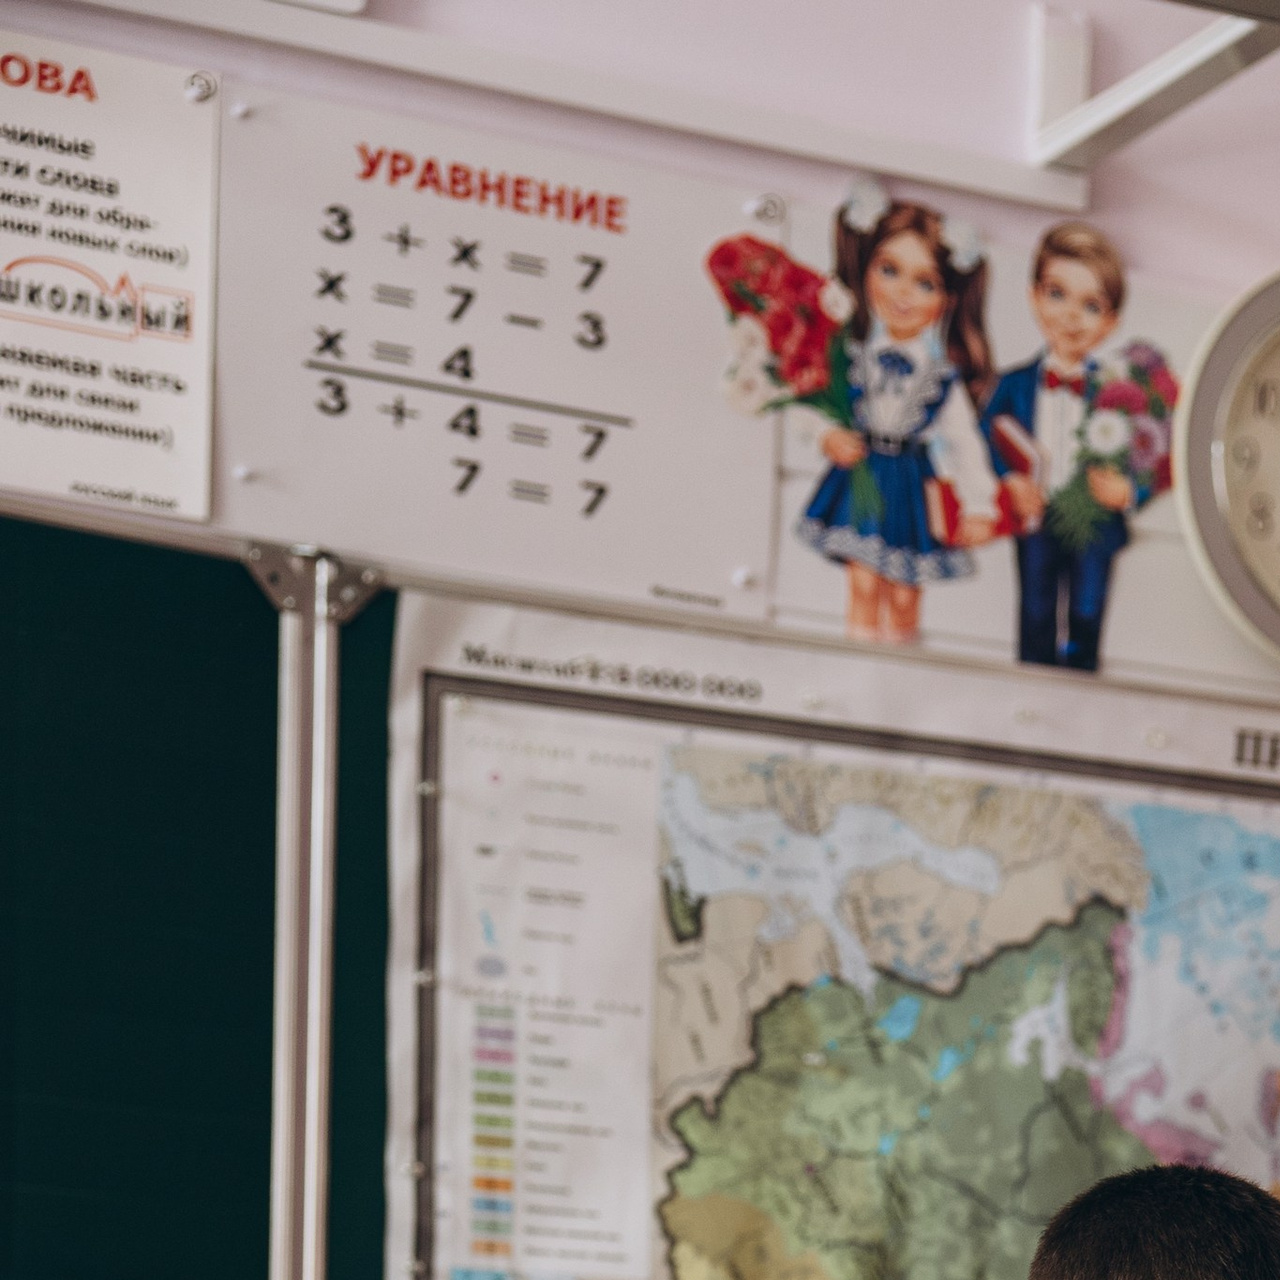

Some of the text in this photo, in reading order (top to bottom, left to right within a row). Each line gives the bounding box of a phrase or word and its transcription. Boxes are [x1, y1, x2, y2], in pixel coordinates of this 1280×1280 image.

[0, 54, 97, 102] ОВА
[357, 143, 627, 233] УРАВНЕНИЕ
[321, 205, 353, 243] 3
[382, 223, 427, 257] +
[506, 251, 546, 277] =
[575, 254, 607, 293] 7
[374, 283, 414, 309] =
[446, 284, 475, 322] 7
[574, 310, 607, 351] 3
[371, 340, 412, 365] =
[442, 345, 474, 381] 4
[317, 378, 609, 461] 3 + 4 = 7
[451, 457, 610, 518] 7 = 7
[1232, 436, 1261, 486] 9
[1246, 491, 1275, 541] 8
